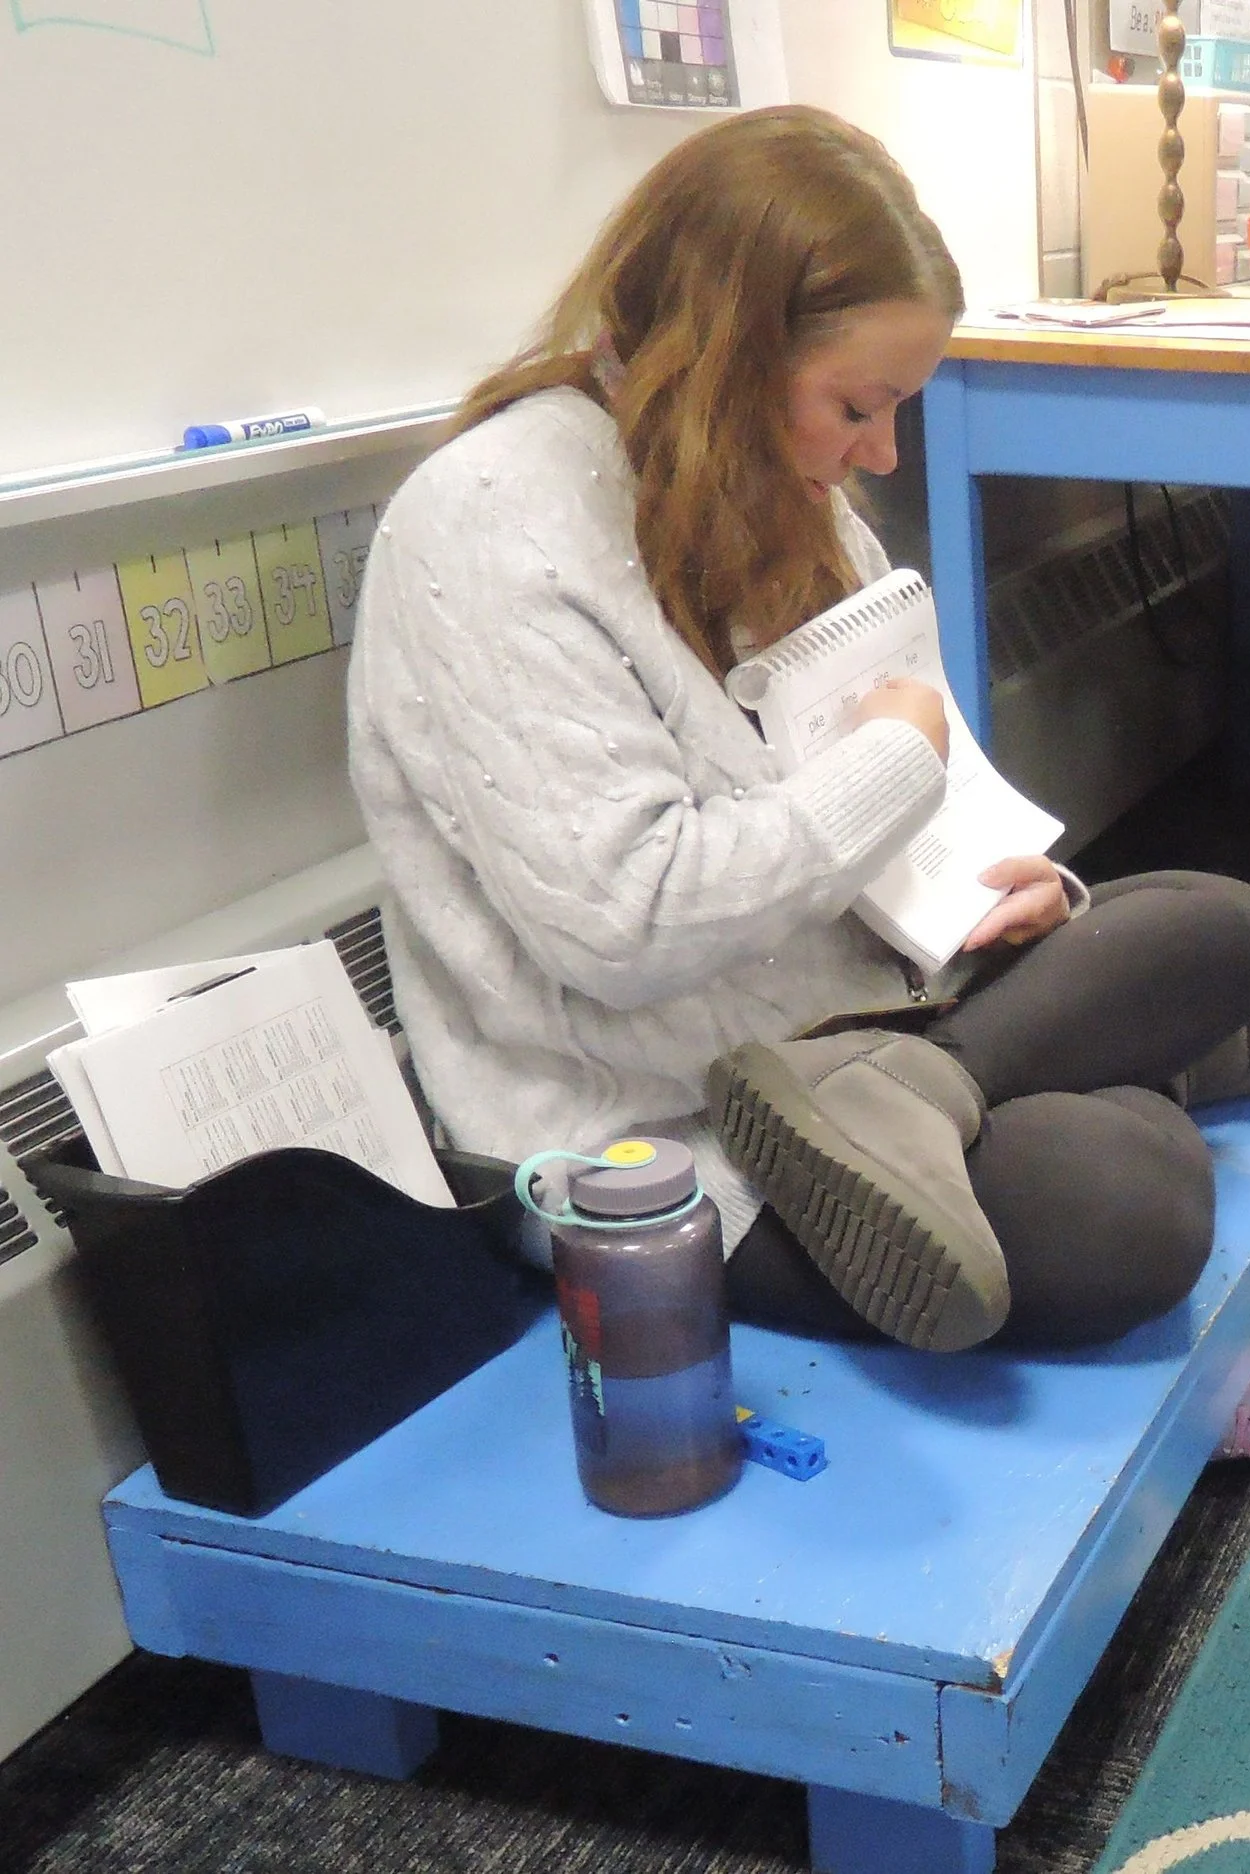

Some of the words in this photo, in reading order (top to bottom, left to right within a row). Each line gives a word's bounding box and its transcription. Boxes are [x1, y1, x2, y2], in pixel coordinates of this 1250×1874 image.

[69, 620, 114, 690] 31
[140, 596, 193, 669] 32
[203, 575, 254, 643] 33
[271, 562, 319, 627] 34
